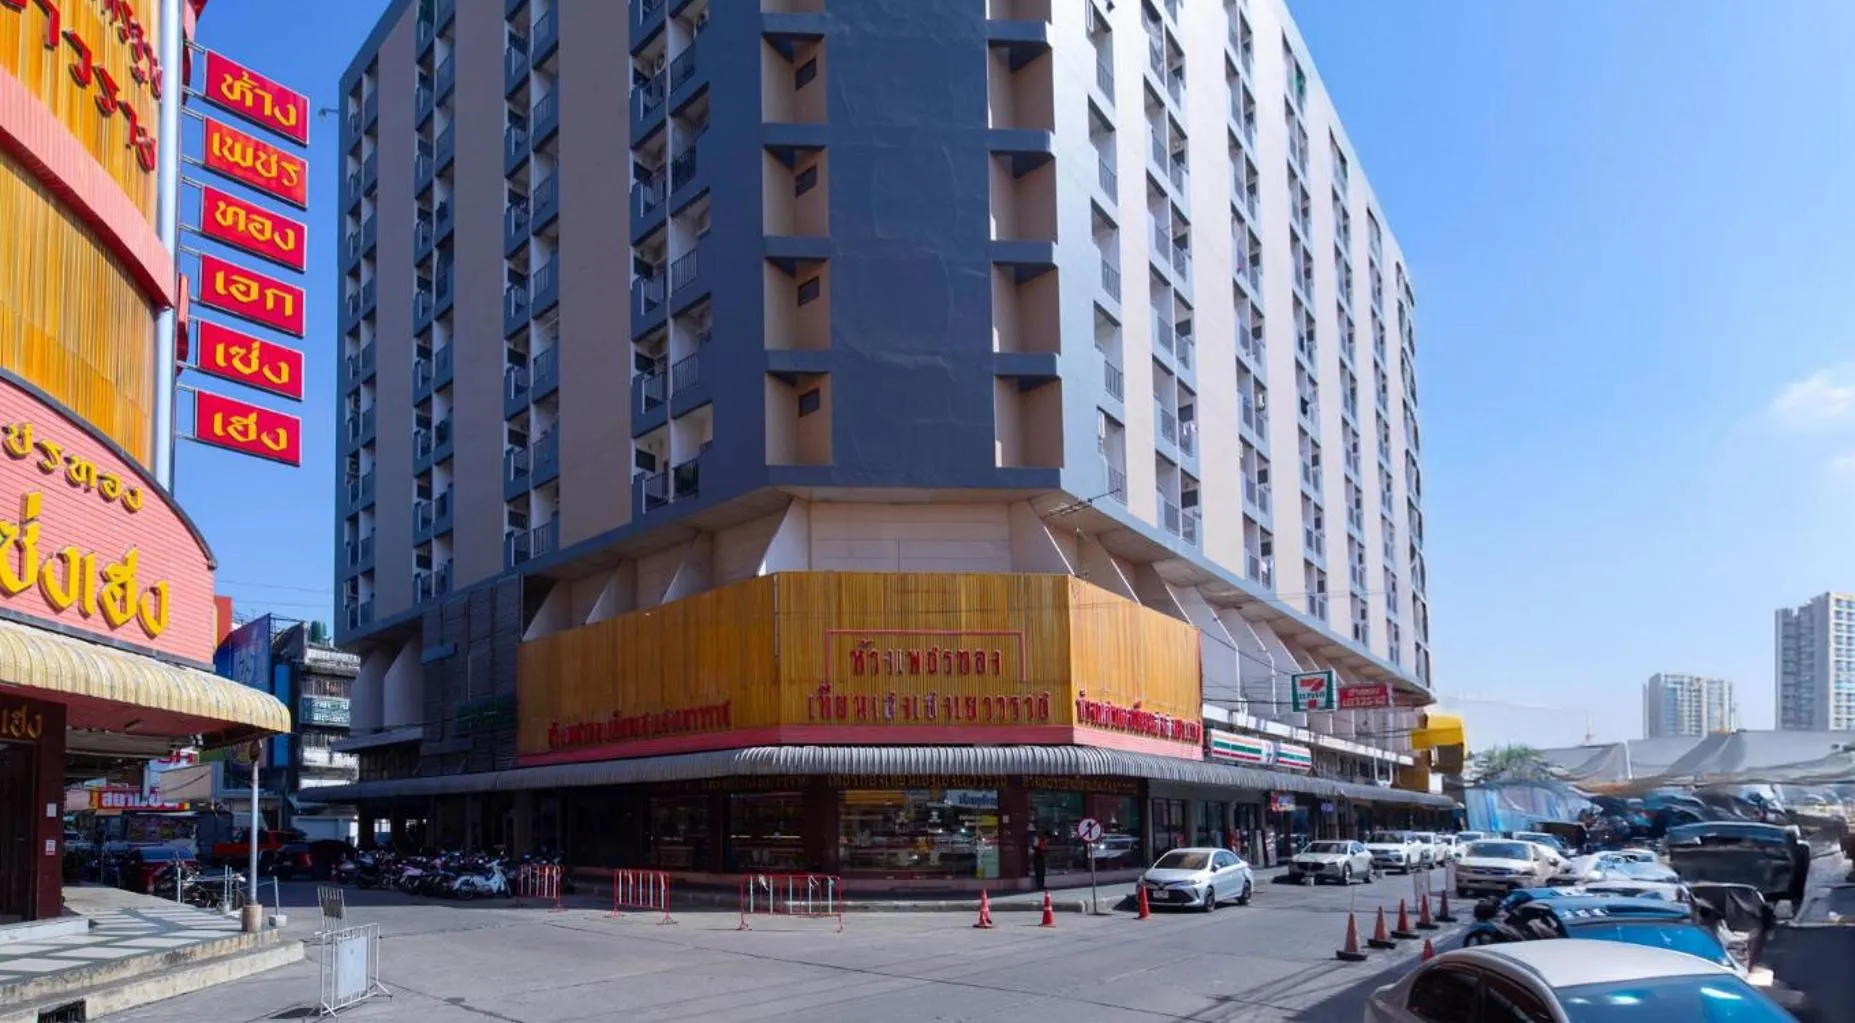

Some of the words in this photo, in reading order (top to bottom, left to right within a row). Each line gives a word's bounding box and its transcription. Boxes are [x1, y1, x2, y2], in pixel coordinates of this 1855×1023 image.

[220, 71, 297, 126] ห้าง
[212, 132, 300, 187] เพชร
[215, 201, 295, 251] ทอง
[215, 270, 293, 317] เอก
[213, 411, 288, 451] เฮง
